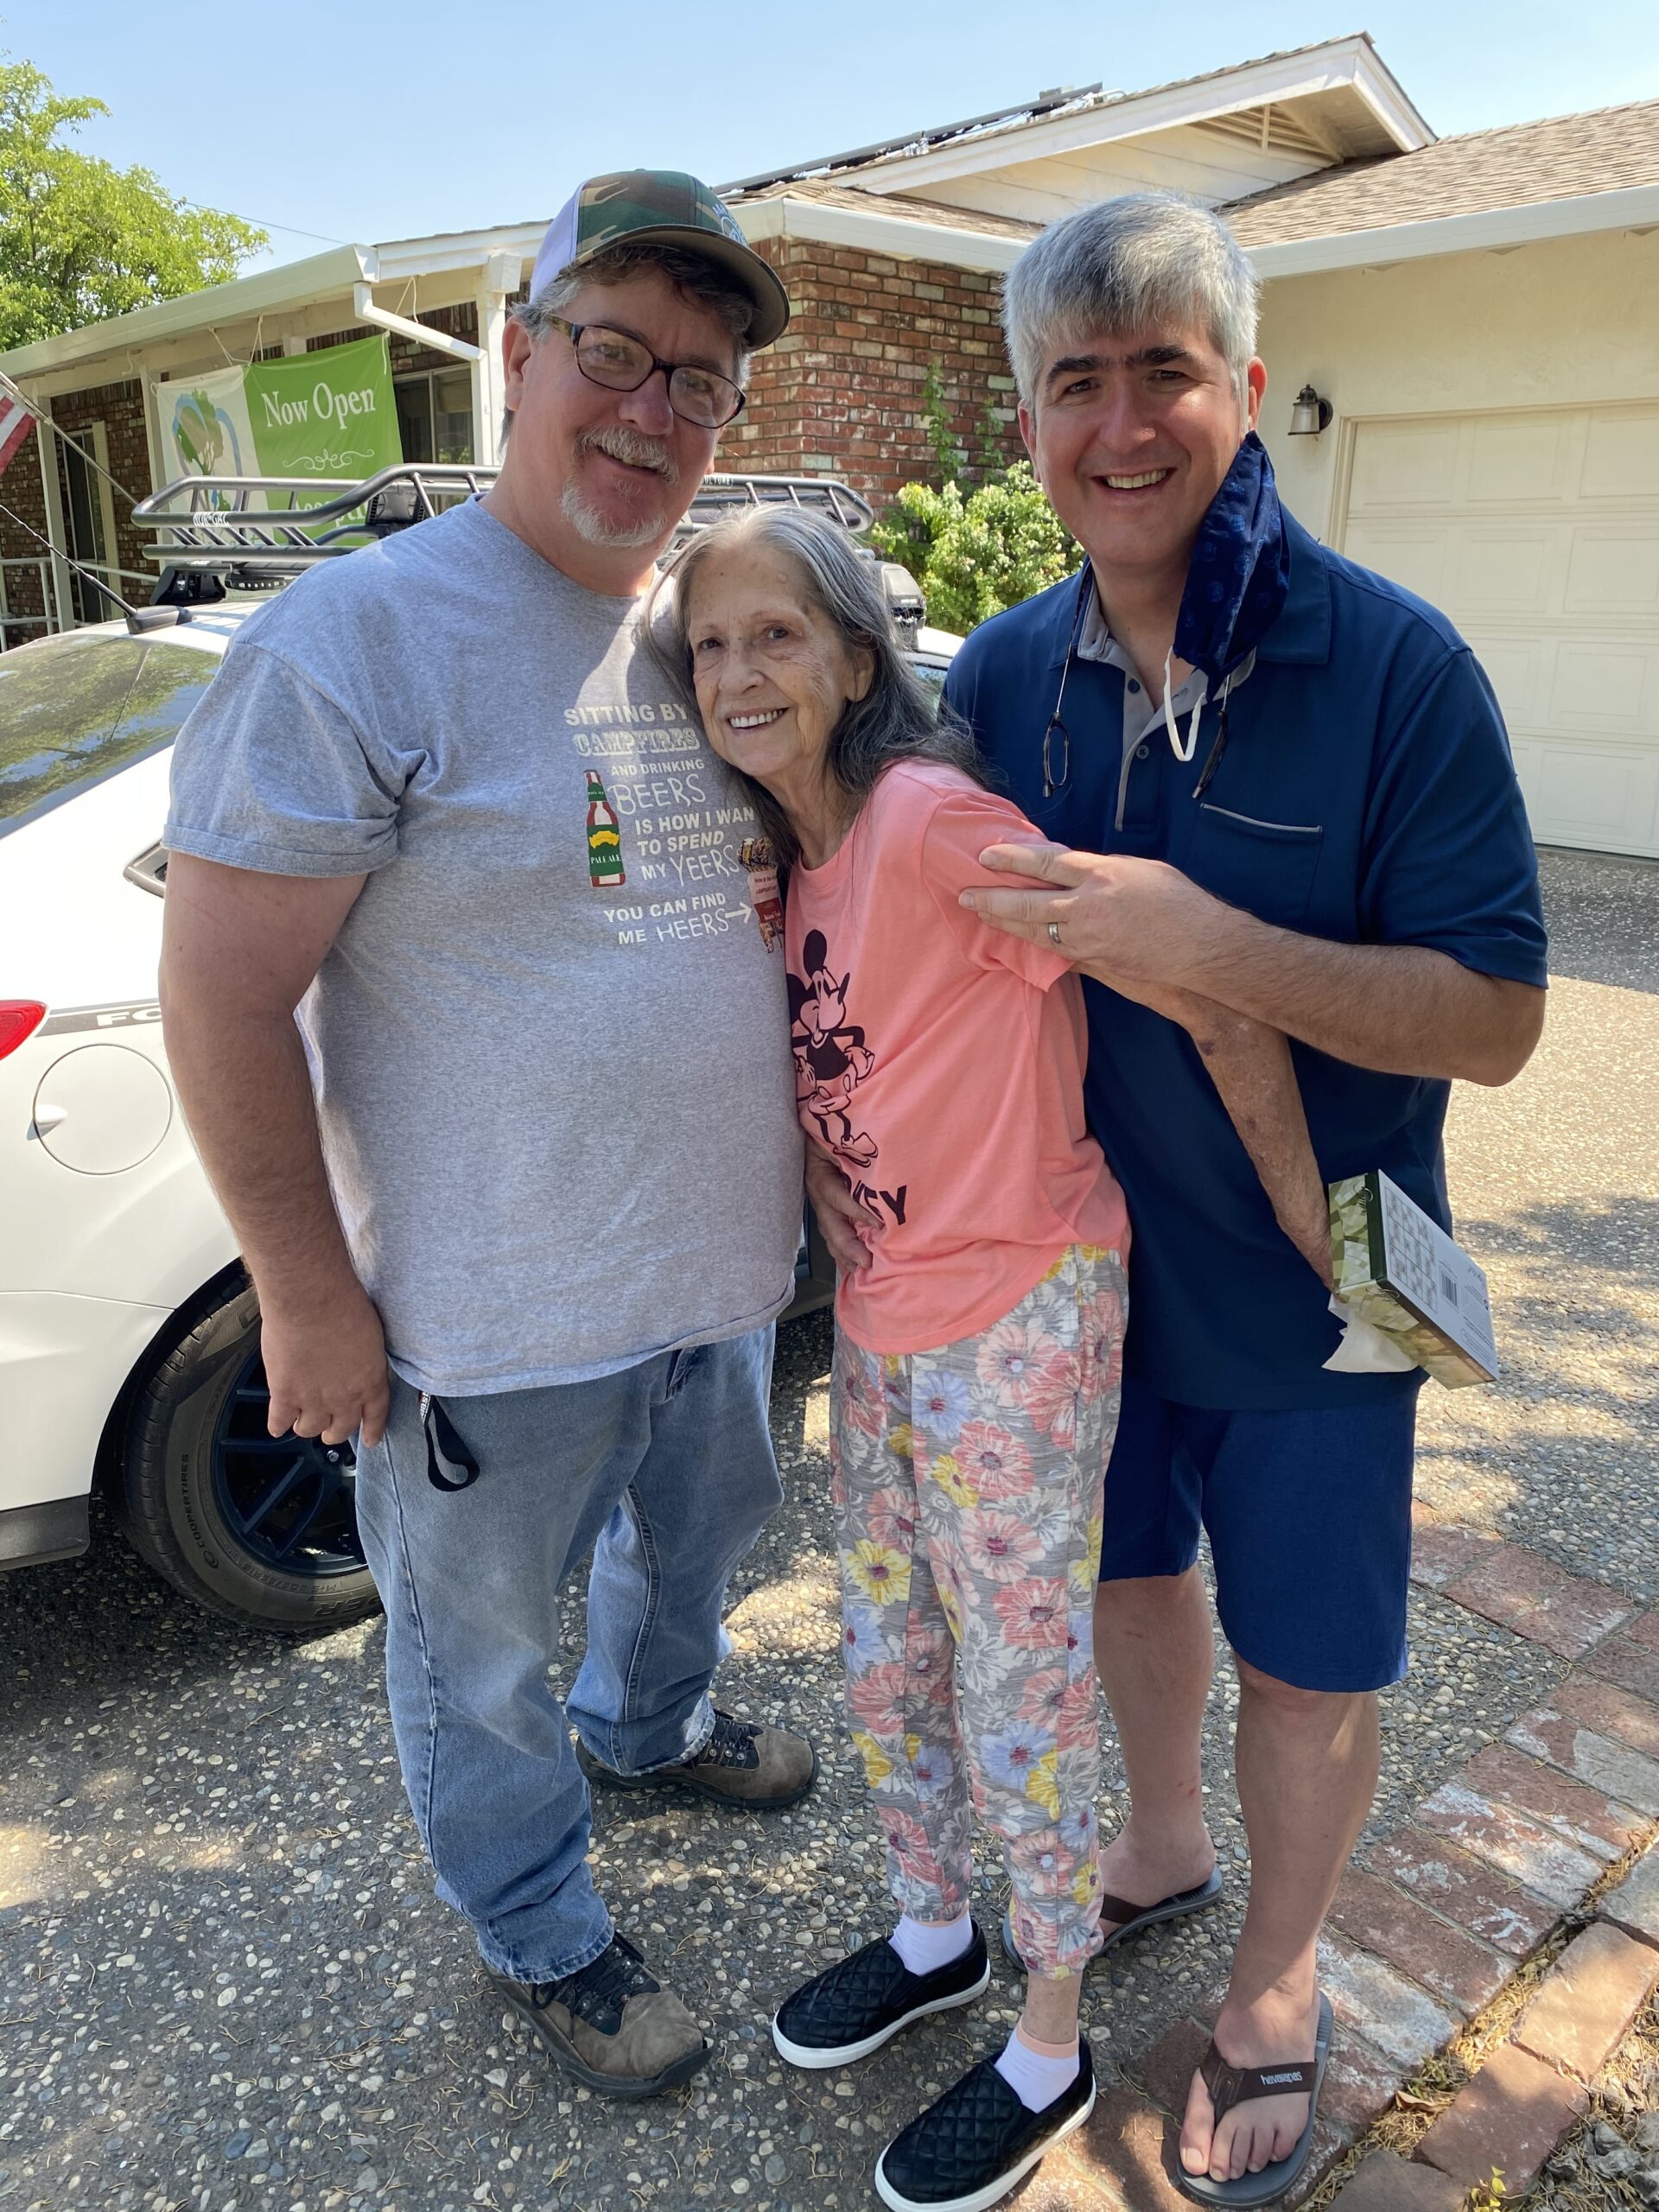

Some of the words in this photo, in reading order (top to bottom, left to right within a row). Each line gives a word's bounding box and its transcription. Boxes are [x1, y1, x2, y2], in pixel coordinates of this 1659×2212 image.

[261, 391, 308, 428] Now
[313, 382, 377, 430] Open
[563, 704, 656, 727] SITTING
[659, 702, 689, 721] BY
[572, 727, 701, 757] CAMPFIRES
[610, 764, 637, 777] AND
[639, 759, 705, 775] DRINKING
[607, 773, 706, 815] BEERS
[635, 818, 653, 836] IS
[658, 812, 700, 833] HOW
[705, 810, 711, 827] I
[715, 807, 755, 825] WAN
[637, 838, 662, 856] TO
[667, 830, 724, 853] SPEND
[590, 855, 607, 865] PALE
[608, 853, 622, 863] ALE
[640, 863, 666, 880] MY
[669, 844, 740, 887] YEERS
[603, 906, 644, 923] YOU
[649, 899, 688, 918] CAN
[691, 892, 727, 910] FIND
[618, 929, 647, 945] ME
[656, 907, 729, 943] HEERS
